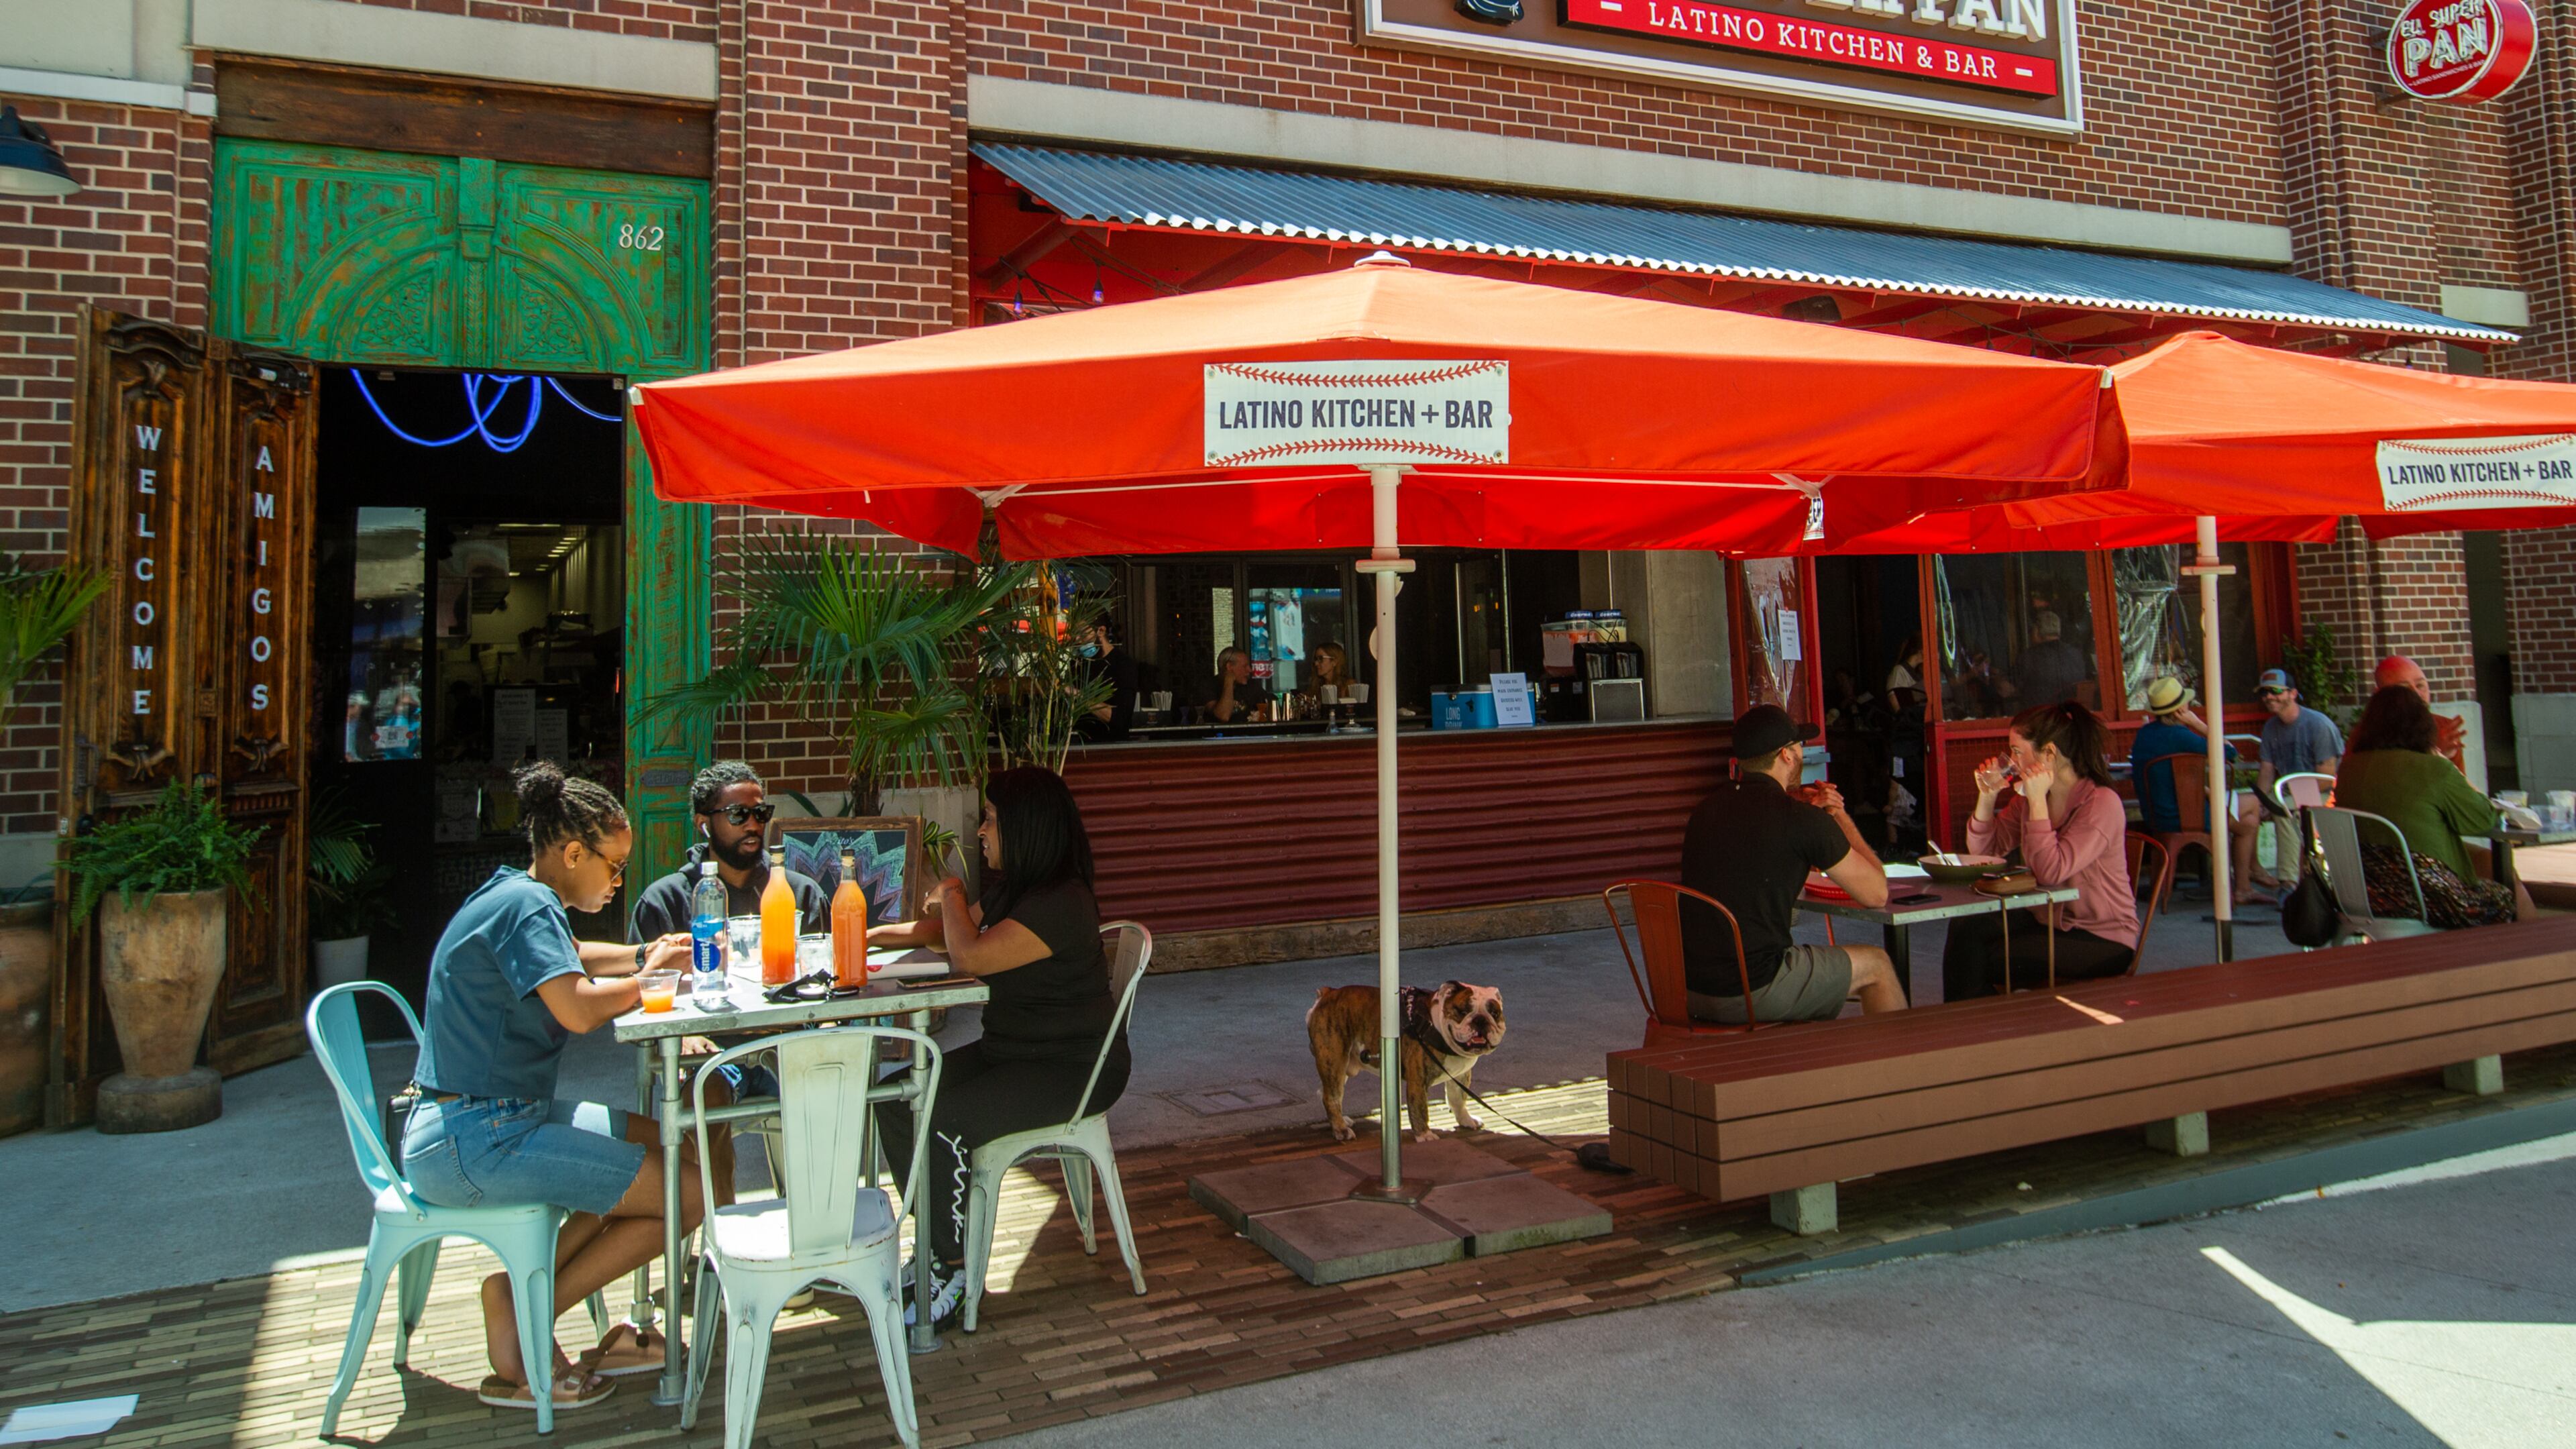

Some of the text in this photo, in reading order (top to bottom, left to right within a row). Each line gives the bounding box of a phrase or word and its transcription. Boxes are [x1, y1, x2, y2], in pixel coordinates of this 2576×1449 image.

[1648, 1, 1765, 42] LATINO
[1777, 22, 1904, 64] KITCHEN
[1917, 46, 1933, 68] &
[1945, 50, 1998, 79] BAR
[2402, 17, 2488, 78] PAN
[619, 223, 664, 251] 862
[1220, 399, 1493, 429] LATINO KITCHEN + BAR
[2387, 460, 2574, 485] LATINO KITCHEN + BAR
[132, 425, 162, 714] WELCOME
[250, 445, 274, 710] AMIGOS
[1446, 706, 1460, 720] LONG
[701, 941, 710, 973] smart
